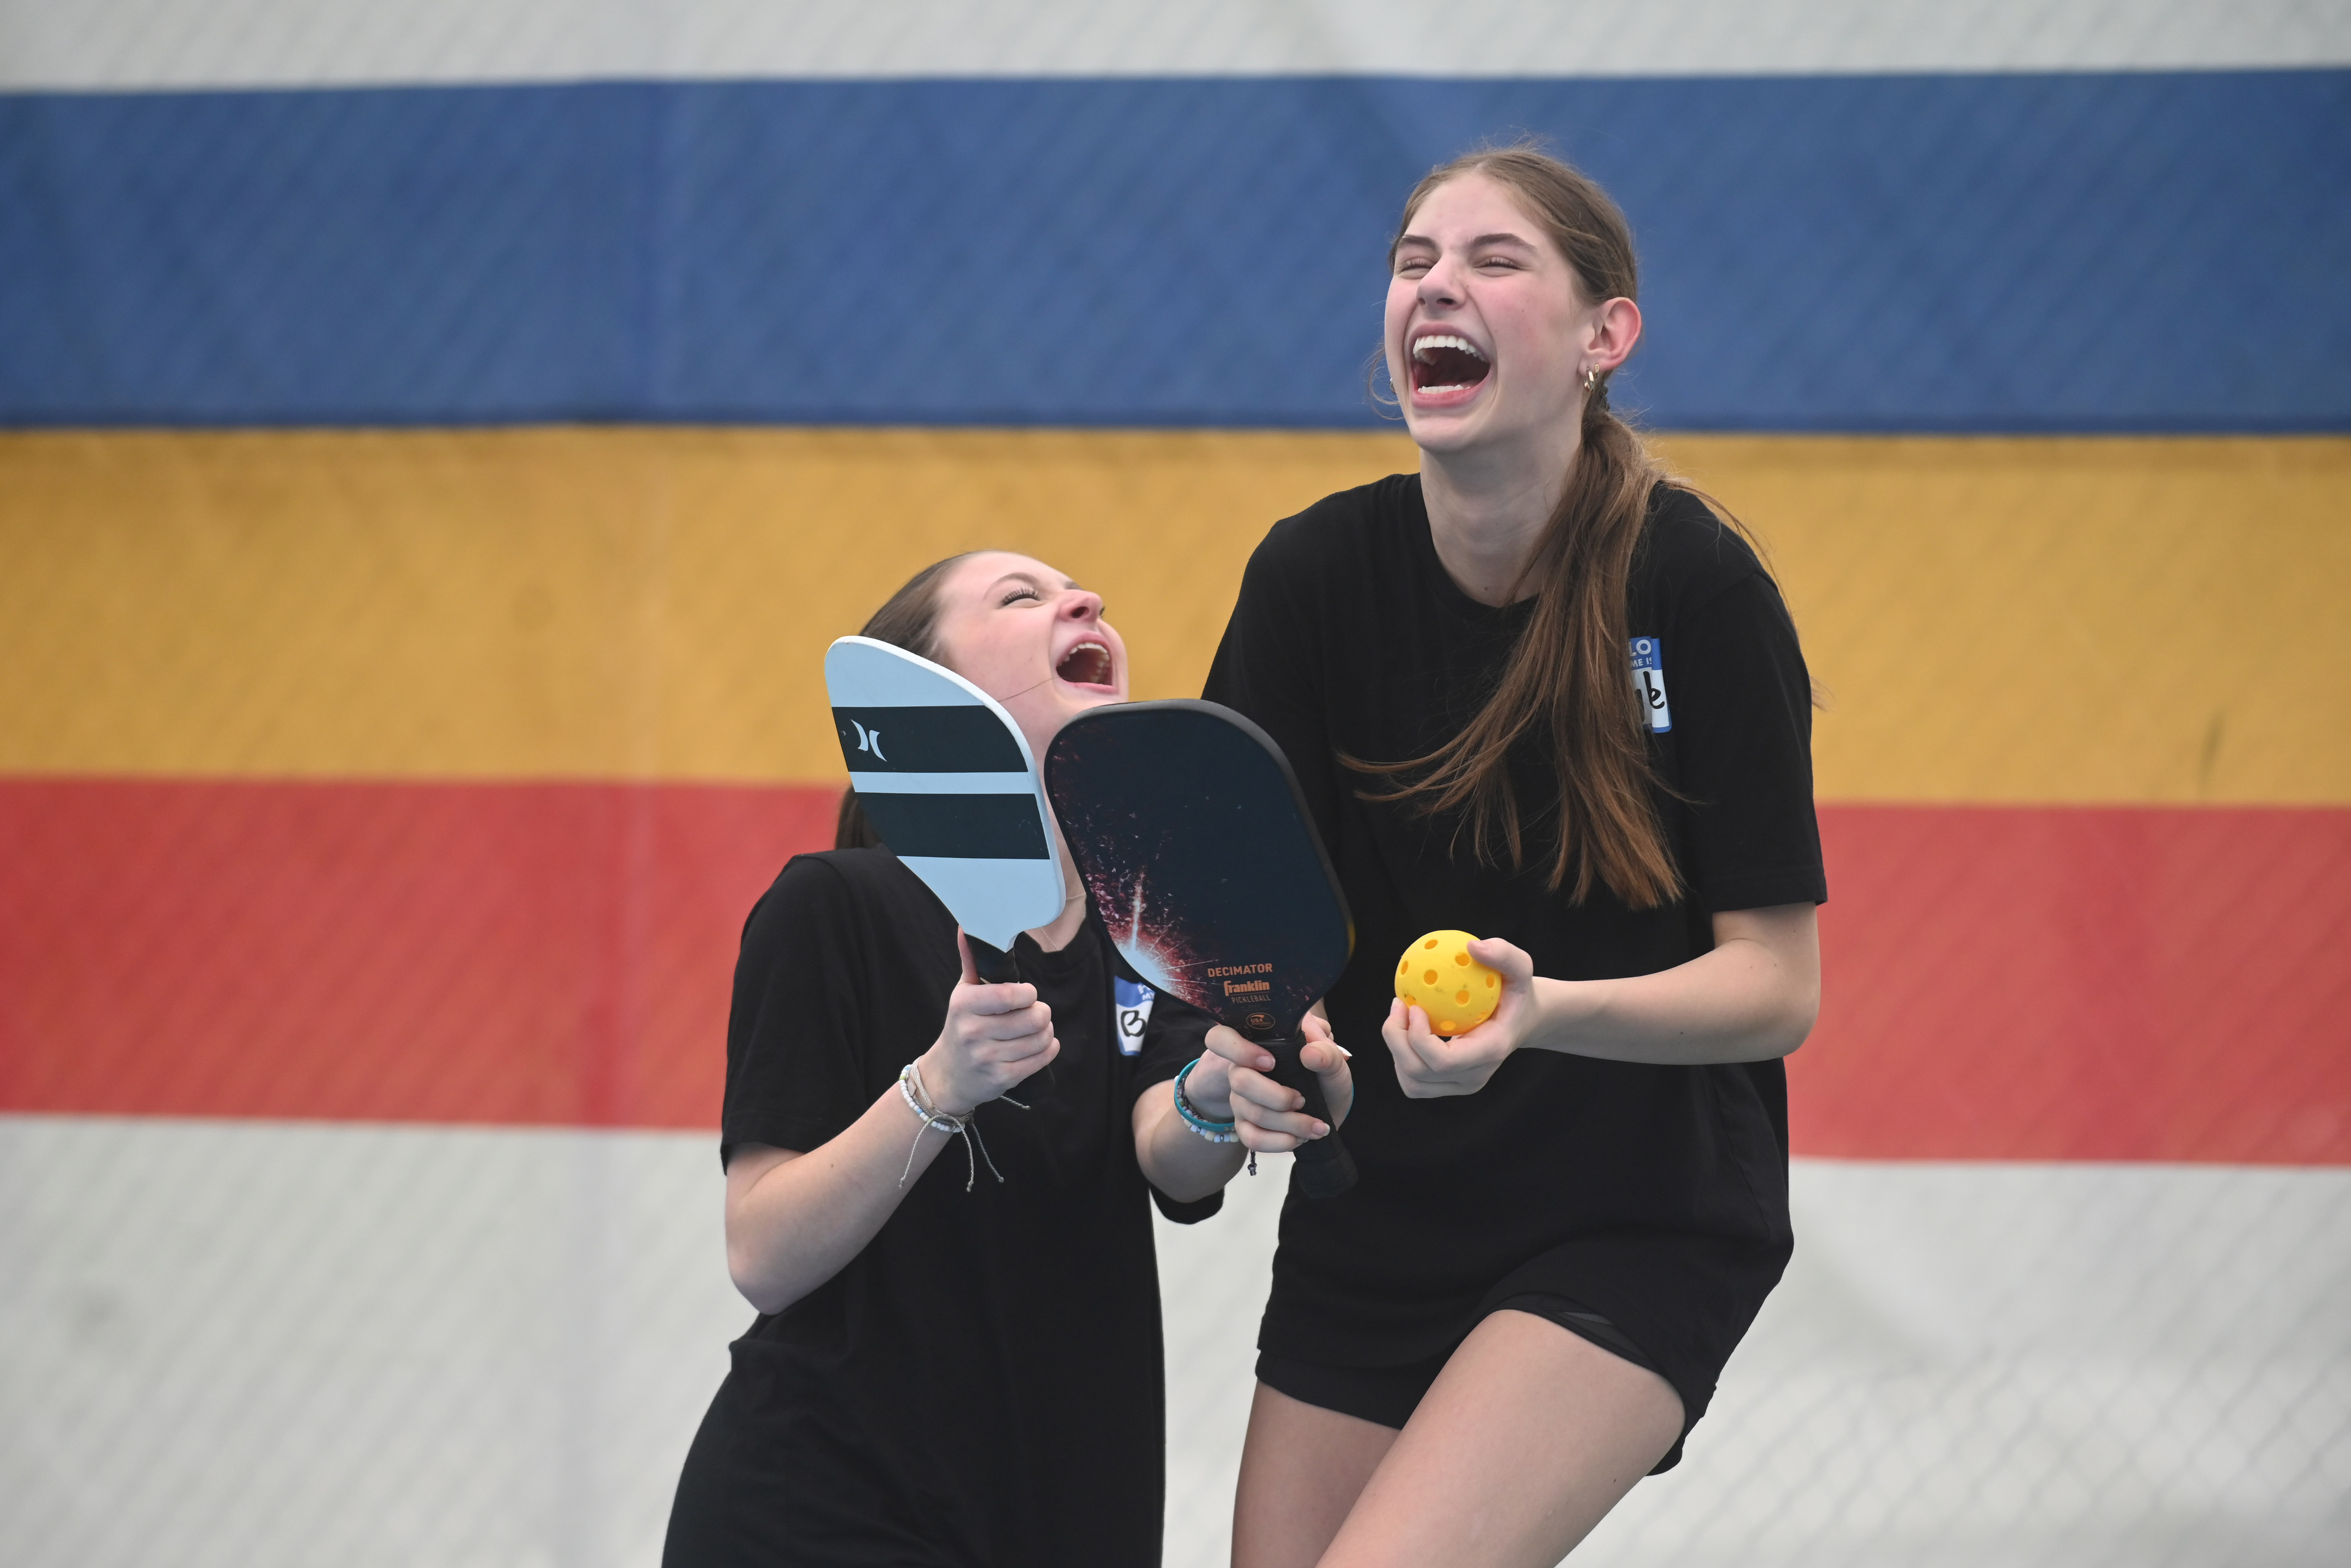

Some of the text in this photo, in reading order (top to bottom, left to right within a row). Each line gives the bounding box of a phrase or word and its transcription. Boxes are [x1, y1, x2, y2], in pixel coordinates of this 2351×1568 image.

[1629, 639, 1651, 656] LO
[1631, 659, 1643, 668] ME
[1207, 963, 1273, 977] DECIMATOR
[1224, 980, 1270, 996] franklin
[1231, 994, 1271, 1003] PICKLEBALL
